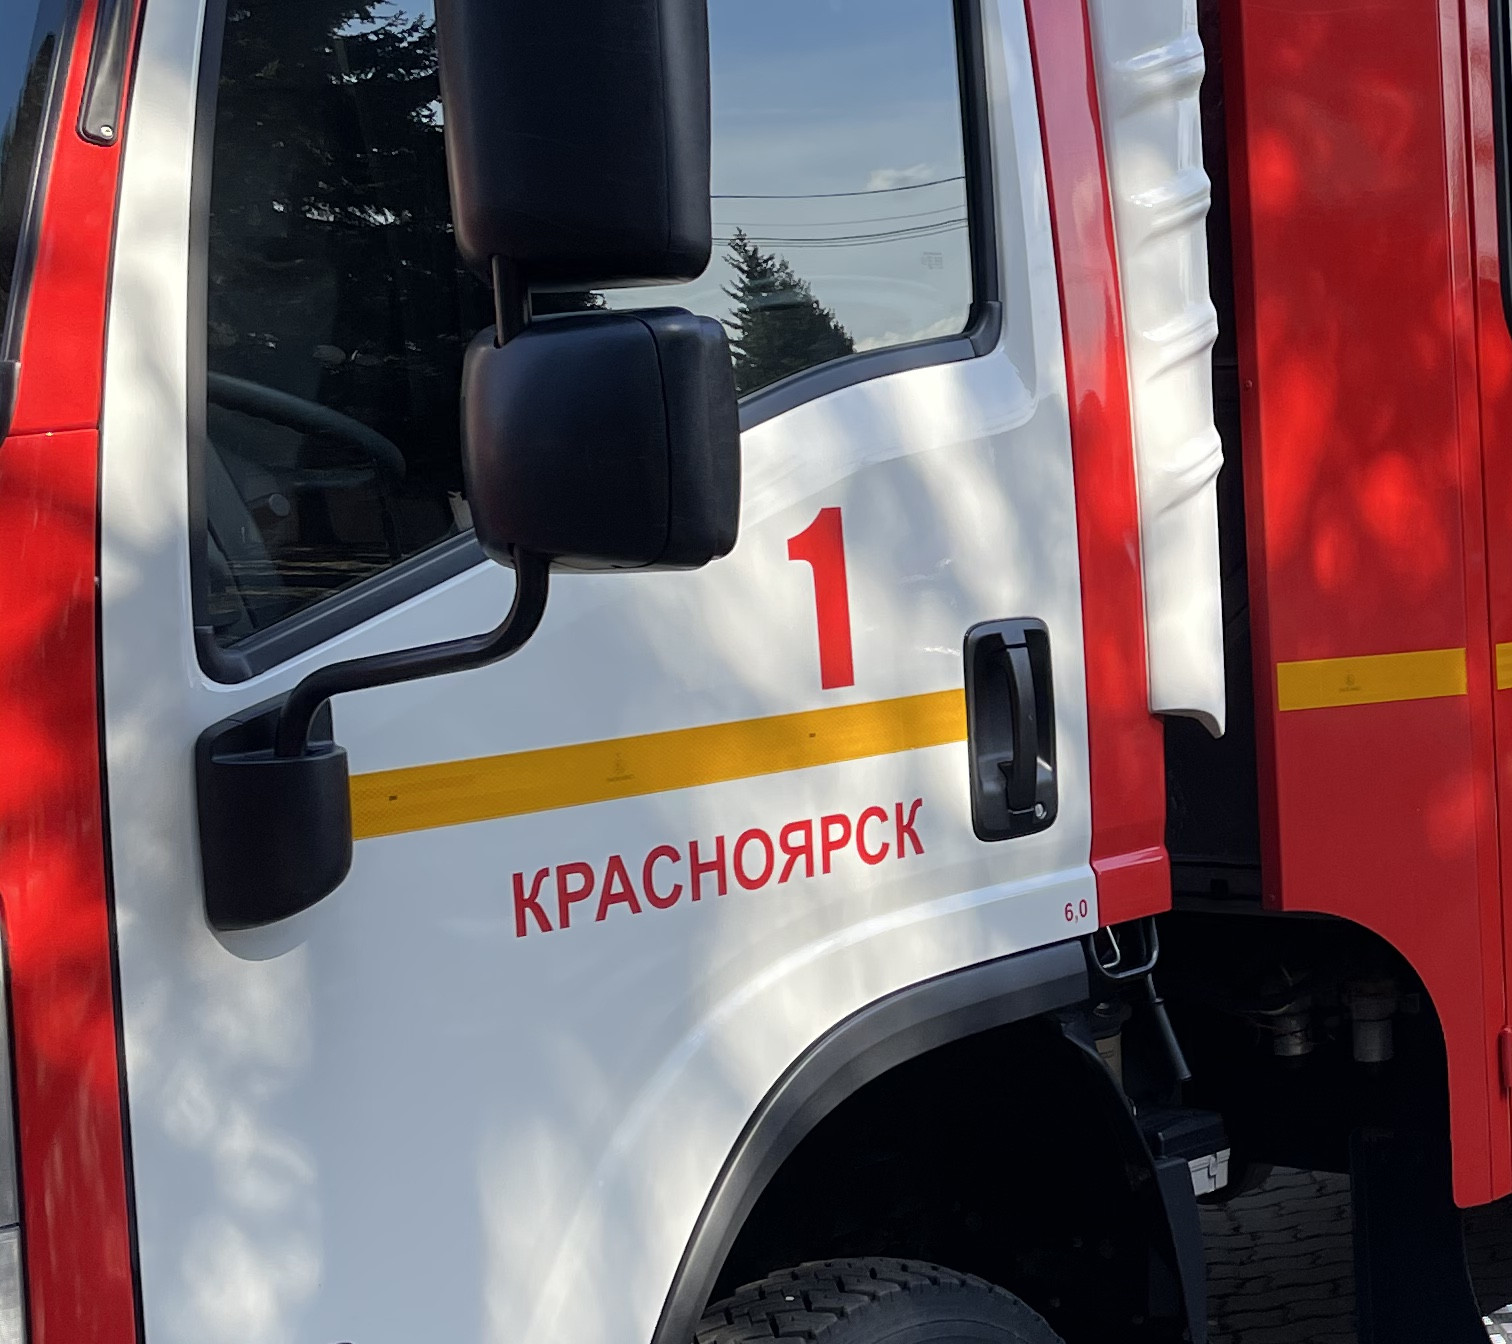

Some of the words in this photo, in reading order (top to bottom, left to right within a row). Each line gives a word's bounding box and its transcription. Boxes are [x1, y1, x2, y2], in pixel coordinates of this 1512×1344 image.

[787, 506, 854, 690] 1
[513, 798, 925, 937] КРАСНОЯРСК
[1064, 899, 1088, 924] 6,0
